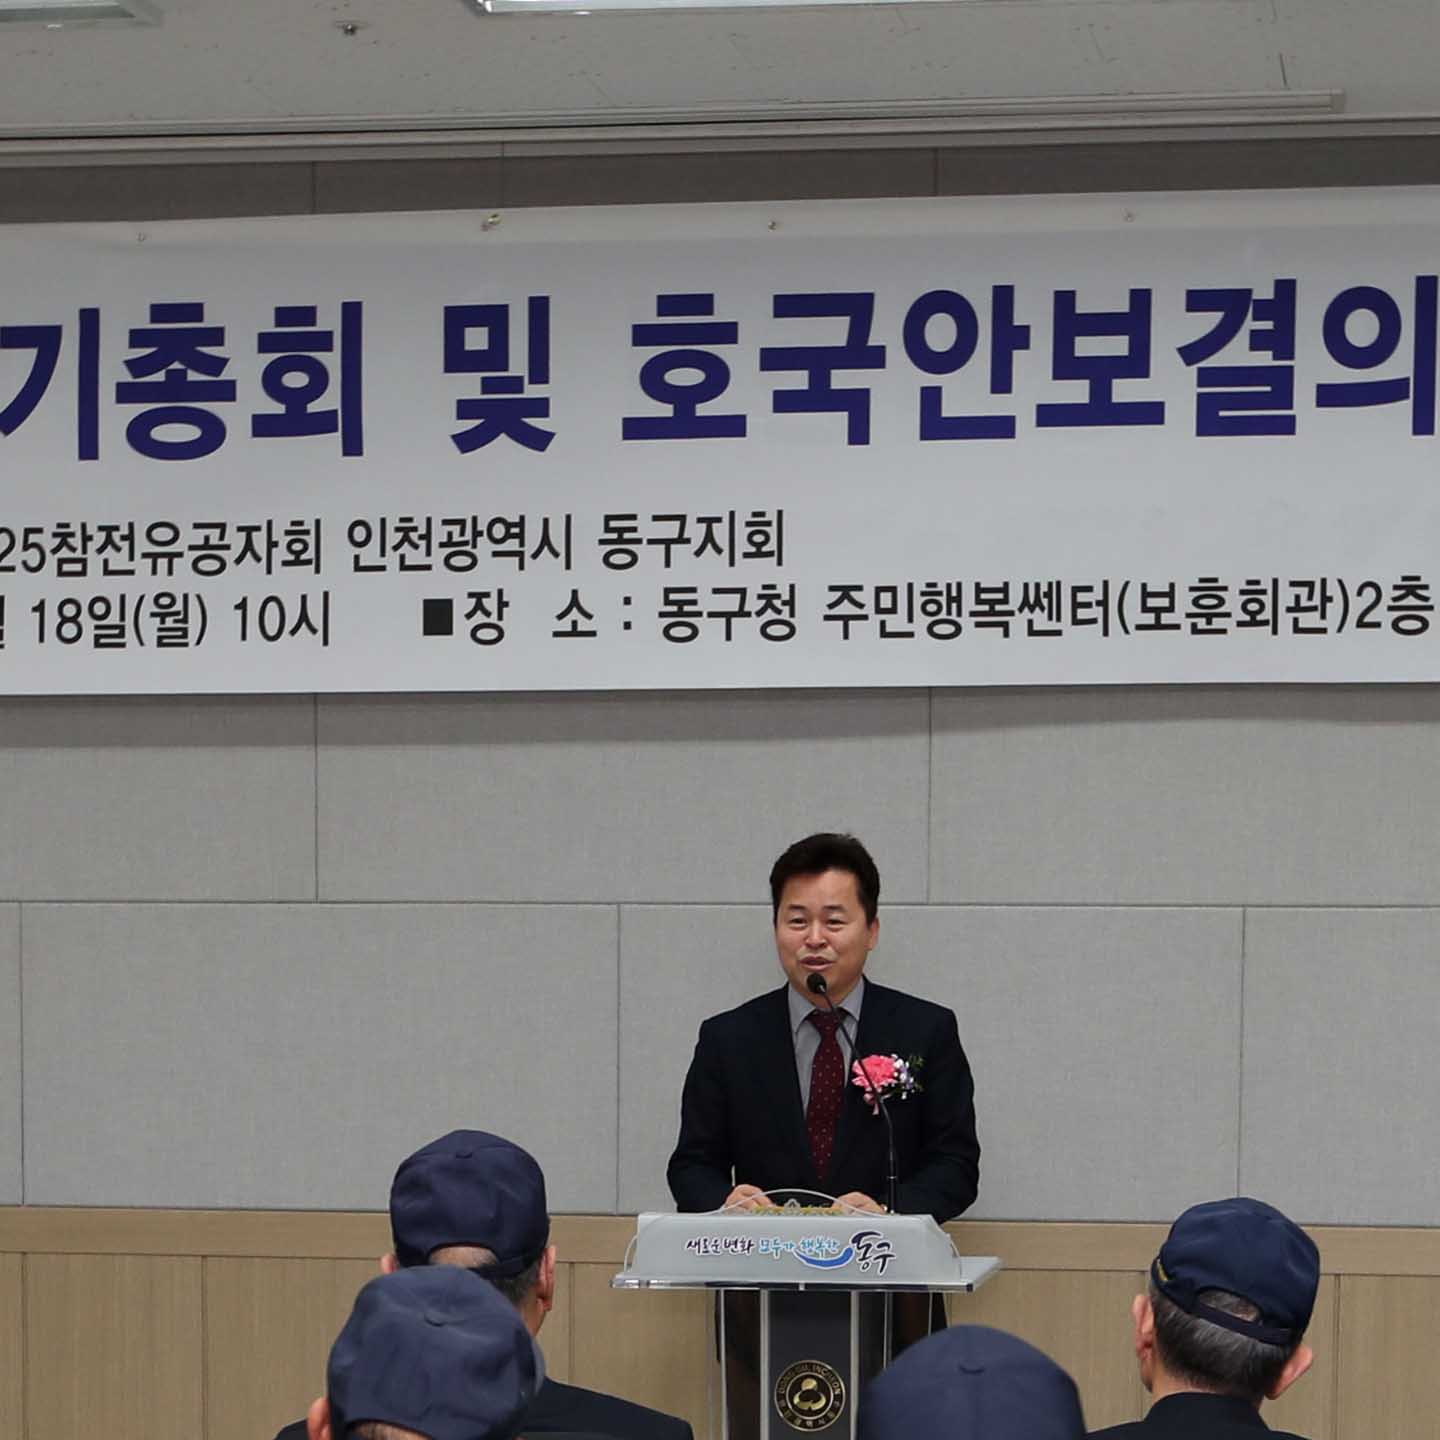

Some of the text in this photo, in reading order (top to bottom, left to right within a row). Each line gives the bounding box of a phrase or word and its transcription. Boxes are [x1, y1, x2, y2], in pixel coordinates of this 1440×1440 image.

[444, 296, 555, 454] 및
[347, 514, 572, 573] 인천광역시
[598, 510, 784, 570] 동구지회
[31, 591, 208, 650] 18일(월)
[233, 590, 331, 647] 10시
[552, 589, 598, 638] 소
[658, 583, 797, 643] 동구청
[823, 575, 1435, 641] 주민행복쎈터(보훈회관)2층
[850, 1229, 895, 1275] 동구
